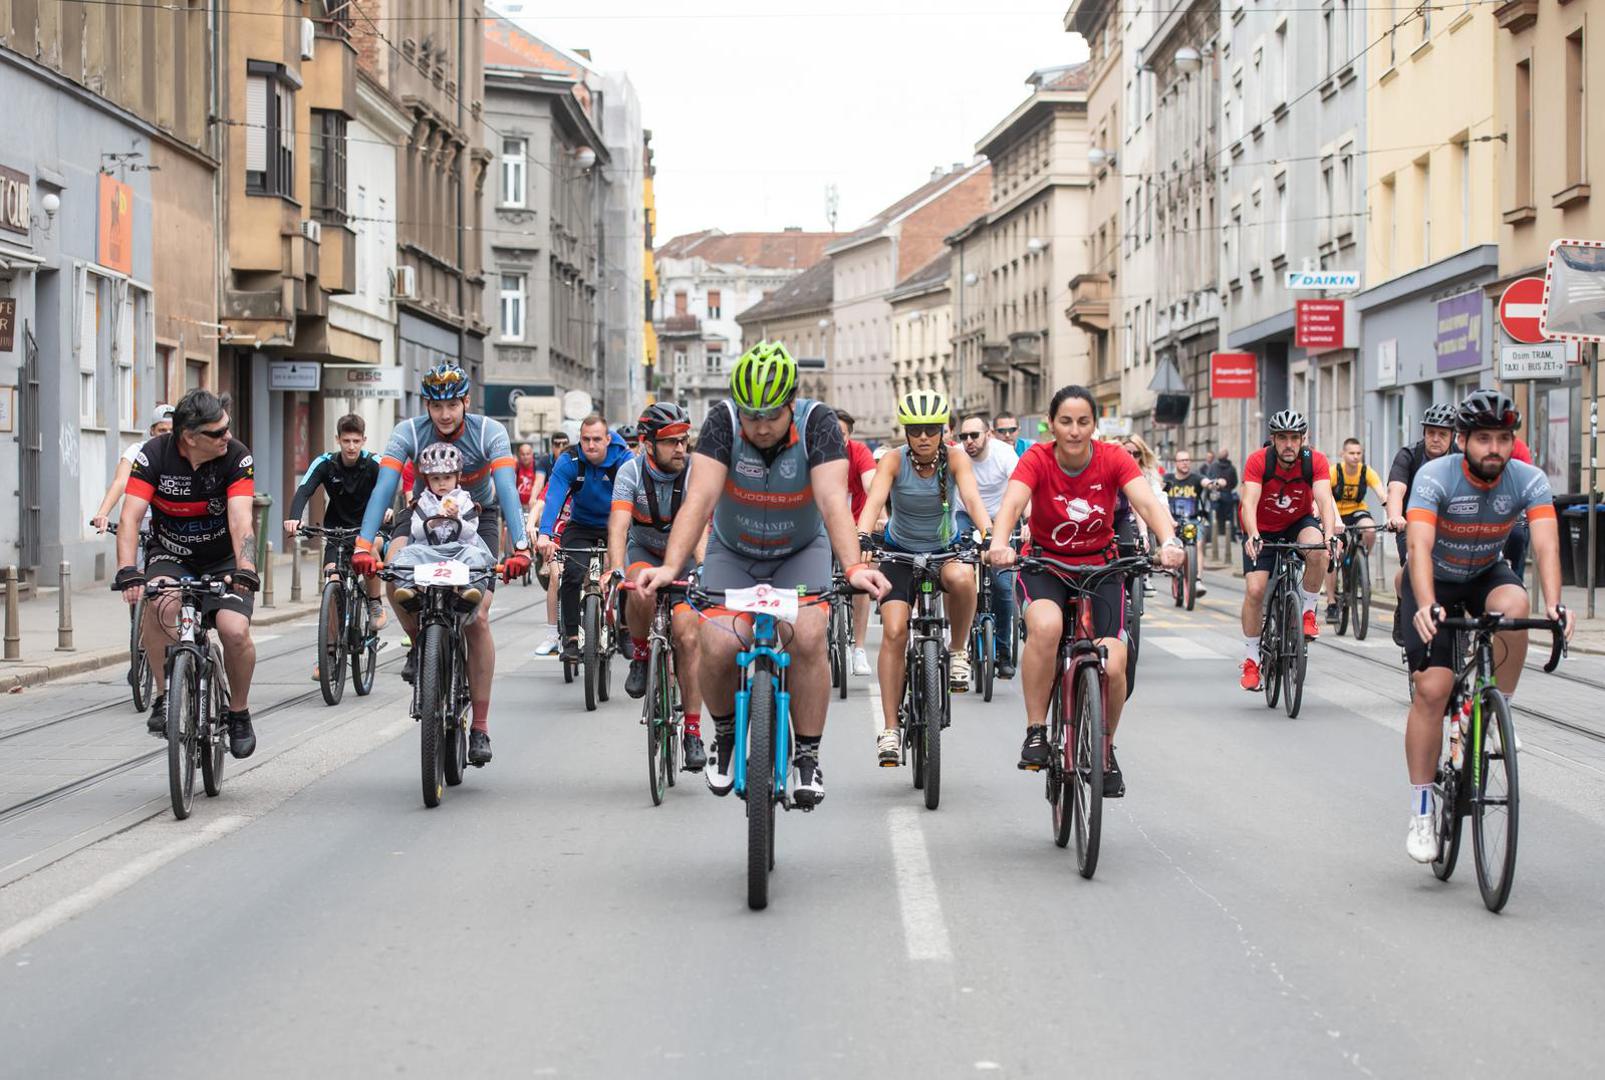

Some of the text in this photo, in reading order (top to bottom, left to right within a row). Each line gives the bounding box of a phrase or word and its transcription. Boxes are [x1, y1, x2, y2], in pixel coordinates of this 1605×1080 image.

[1303, 276, 1355, 285] DAIKIN
[1512, 351, 1530, 360] Osim
[1504, 363, 1519, 371] TAXI
[1527, 362, 1542, 371] BUS
[433, 568, 452, 578] 22
